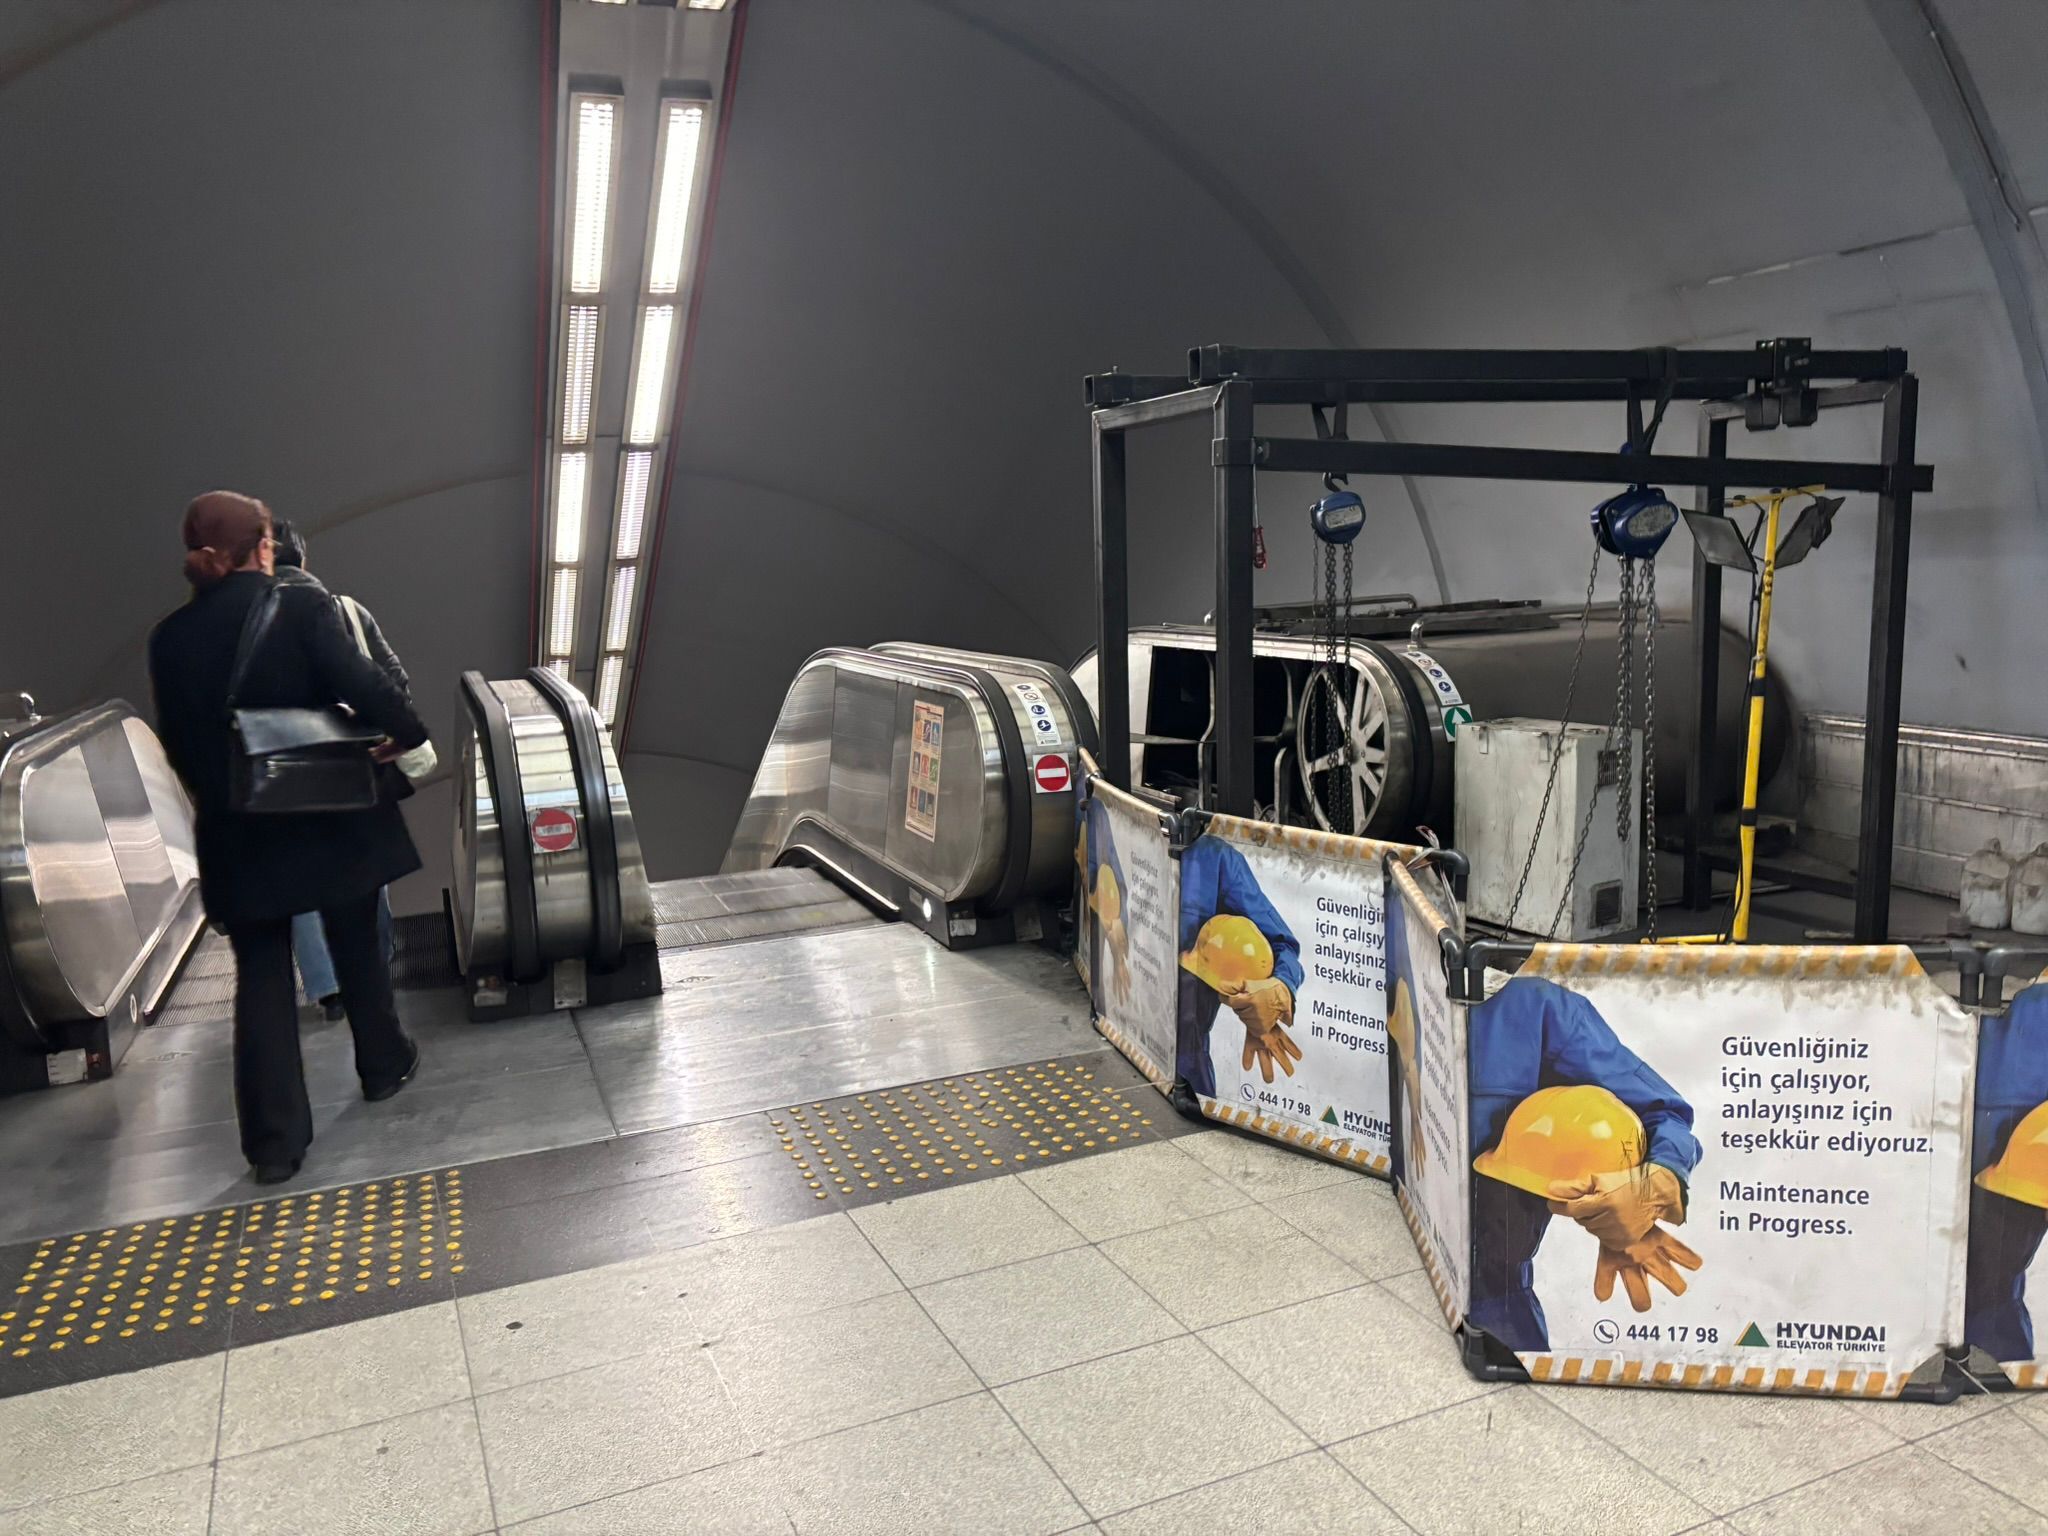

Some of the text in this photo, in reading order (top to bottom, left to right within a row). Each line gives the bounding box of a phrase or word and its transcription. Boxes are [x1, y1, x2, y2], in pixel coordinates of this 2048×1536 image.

[1315, 917, 1338, 938] için
[1314, 942, 1386, 970] anlayışınız
[1314, 962, 1372, 989] teşekkür
[1311, 1021, 1324, 1038] in
[1721, 1035, 1869, 1064] Güvenliğiniz
[1721, 1066, 1870, 1094] için çalışıyor,
[1258, 1091, 1312, 1116] 444 17 98
[1721, 1098, 1893, 1127] anlayışınız için
[1343, 1122, 1377, 1140] ELEVATOR
[1720, 1128, 1934, 1157] teşekkür ediyoruz.
[1719, 1180, 1870, 1206] Maintenance
[1719, 1210, 1853, 1238] in Progress.
[1626, 1324, 1719, 1344] 444 17 98
[1776, 1321, 1886, 1342] HYUNDAI
[1776, 1340, 1886, 1353] ELEVATOR TÜRKİYE
